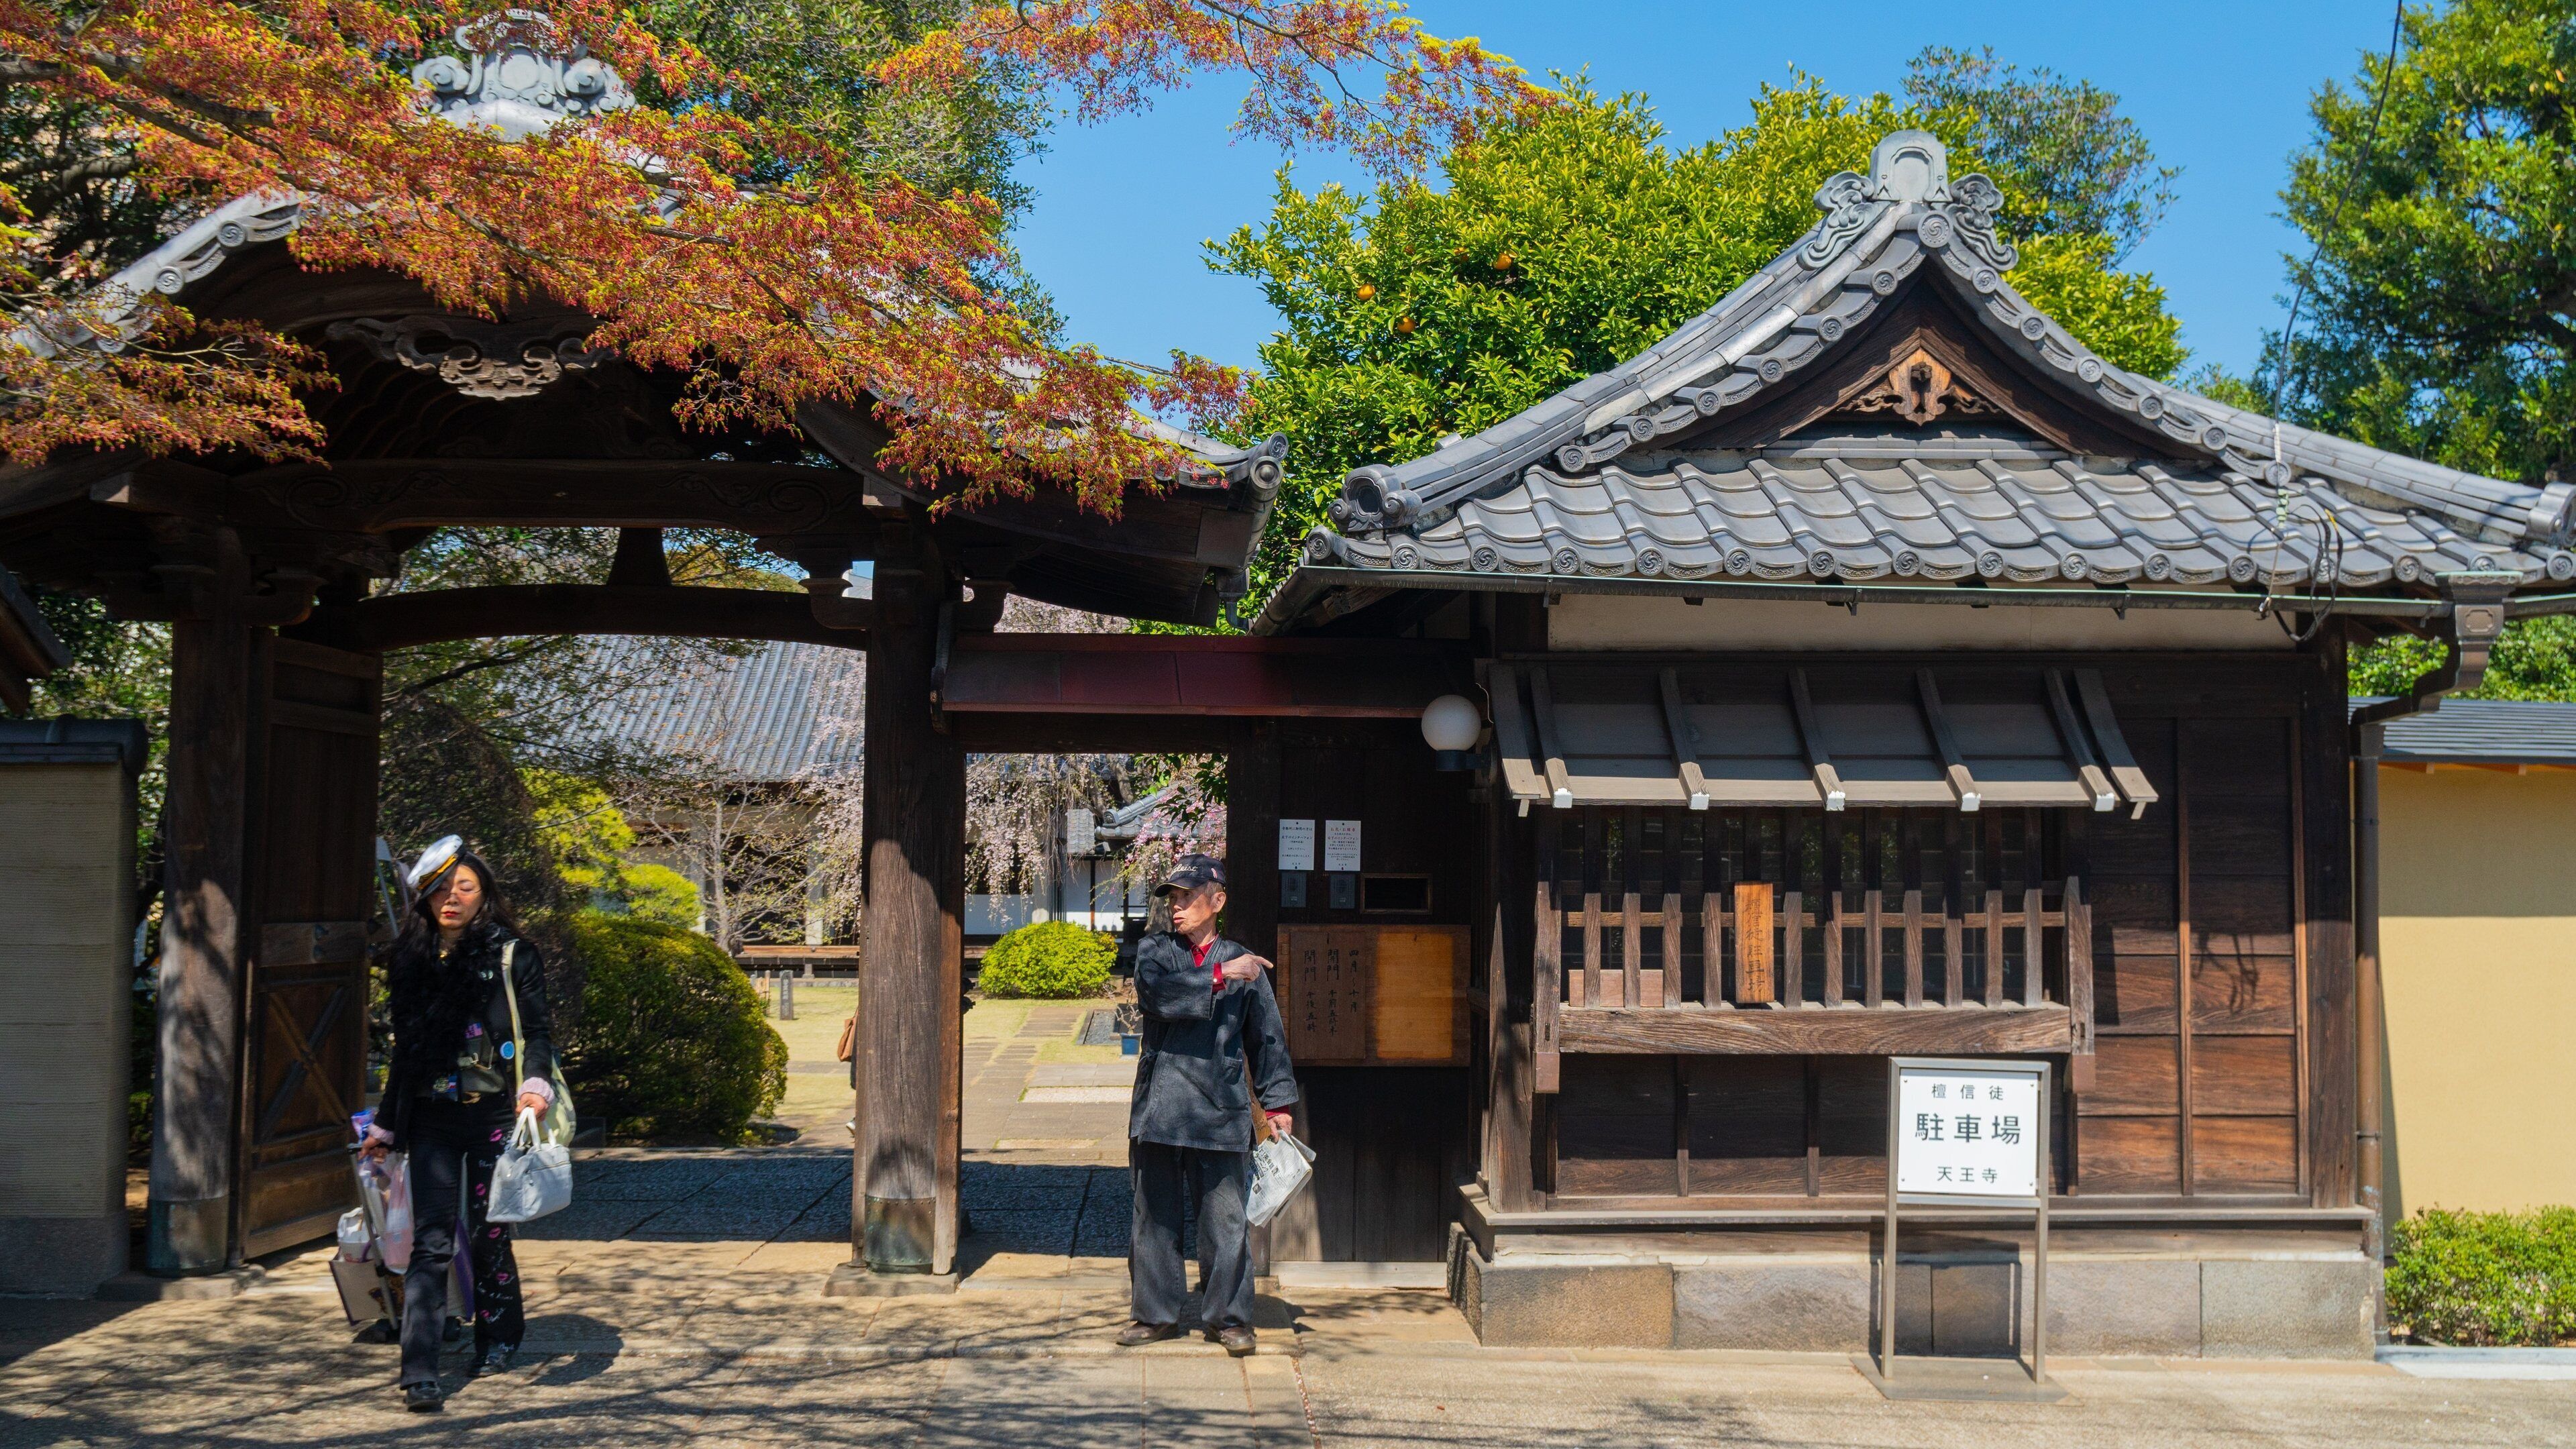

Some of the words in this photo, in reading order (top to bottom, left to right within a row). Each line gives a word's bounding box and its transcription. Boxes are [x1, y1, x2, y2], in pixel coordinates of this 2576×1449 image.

[1326, 949, 1340, 981] 開門
[1931, 1083, 2004, 1101] 檀信徒
[1915, 1112, 2021, 1144] 駐車場
[1937, 1165, 1998, 1184] 天王寺
